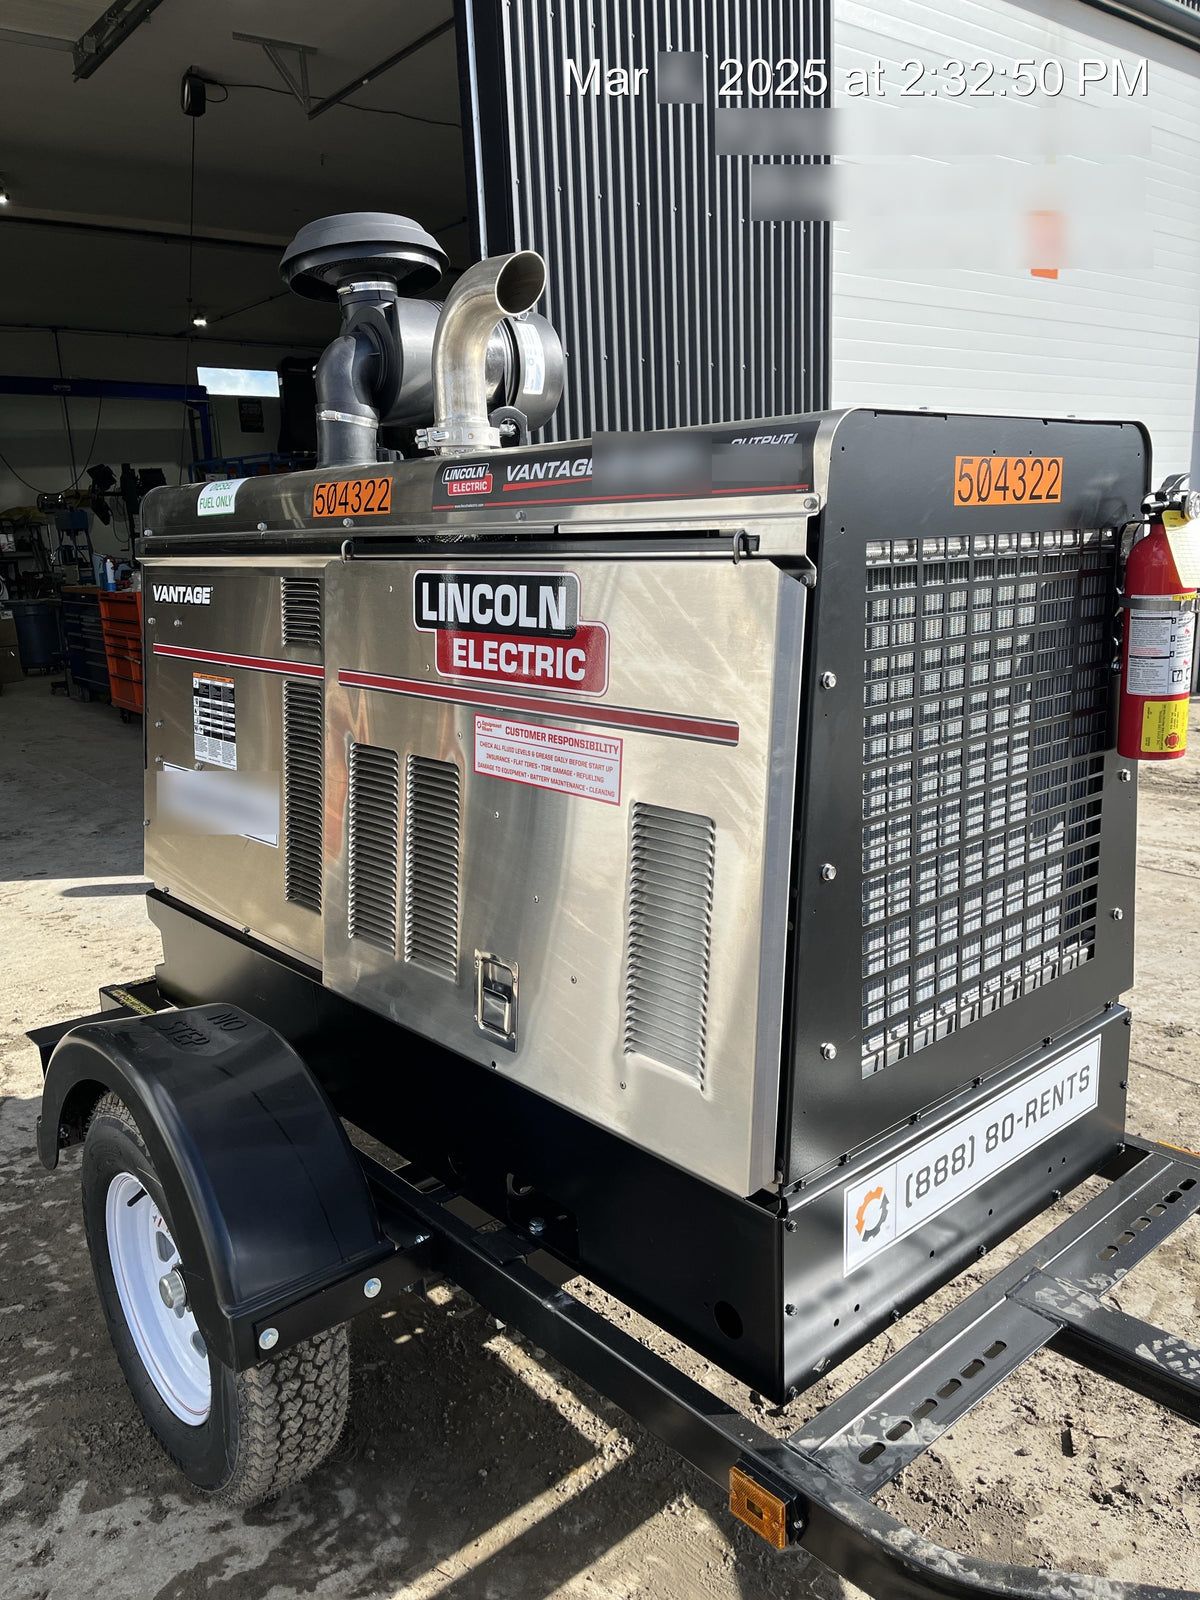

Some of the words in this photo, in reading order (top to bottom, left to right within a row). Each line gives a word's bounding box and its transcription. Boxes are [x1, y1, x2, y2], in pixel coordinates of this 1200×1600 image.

[209, 482, 234, 491] DIESEL
[444, 466, 486, 481] LINCOLN
[453, 481, 487, 493] ELECTRIC
[958, 458, 1060, 502] 504322
[199, 497, 215, 509] FUEL
[215, 495, 233, 507] ONLY
[315, 478, 390, 515] 504322
[153, 585, 211, 604] VANTAGE
[422, 582, 567, 630] LINCOLN
[453, 638, 586, 681] ELECTRIC
[505, 726, 547, 742] CUSTOMER
[548, 734, 619, 755] RESPONSIBILITY
[486, 753, 510, 763] INSURANCE
[524, 761, 538, 769] TIRES
[541, 764, 552, 772] TIRE
[552, 767, 573, 776] DAMAGE
[576, 772, 604, 783] REFUELING
[536, 752, 553, 761] GREASE
[569, 759, 588, 768] BEFORE
[588, 763, 604, 771] START
[477, 762, 494, 771] DAMAGE
[502, 767, 527, 777] EQUIPMENT
[530, 773, 550, 782] BATTERY
[550, 778, 585, 791] MAINTENANCE
[589, 786, 615, 797] CLEANING
[159, 1021, 210, 1046] STEP
[207, 1012, 248, 1031] NO
[905, 1135, 975, 1209] (888)
[985, 1065, 1090, 1154] 80-RENTS
